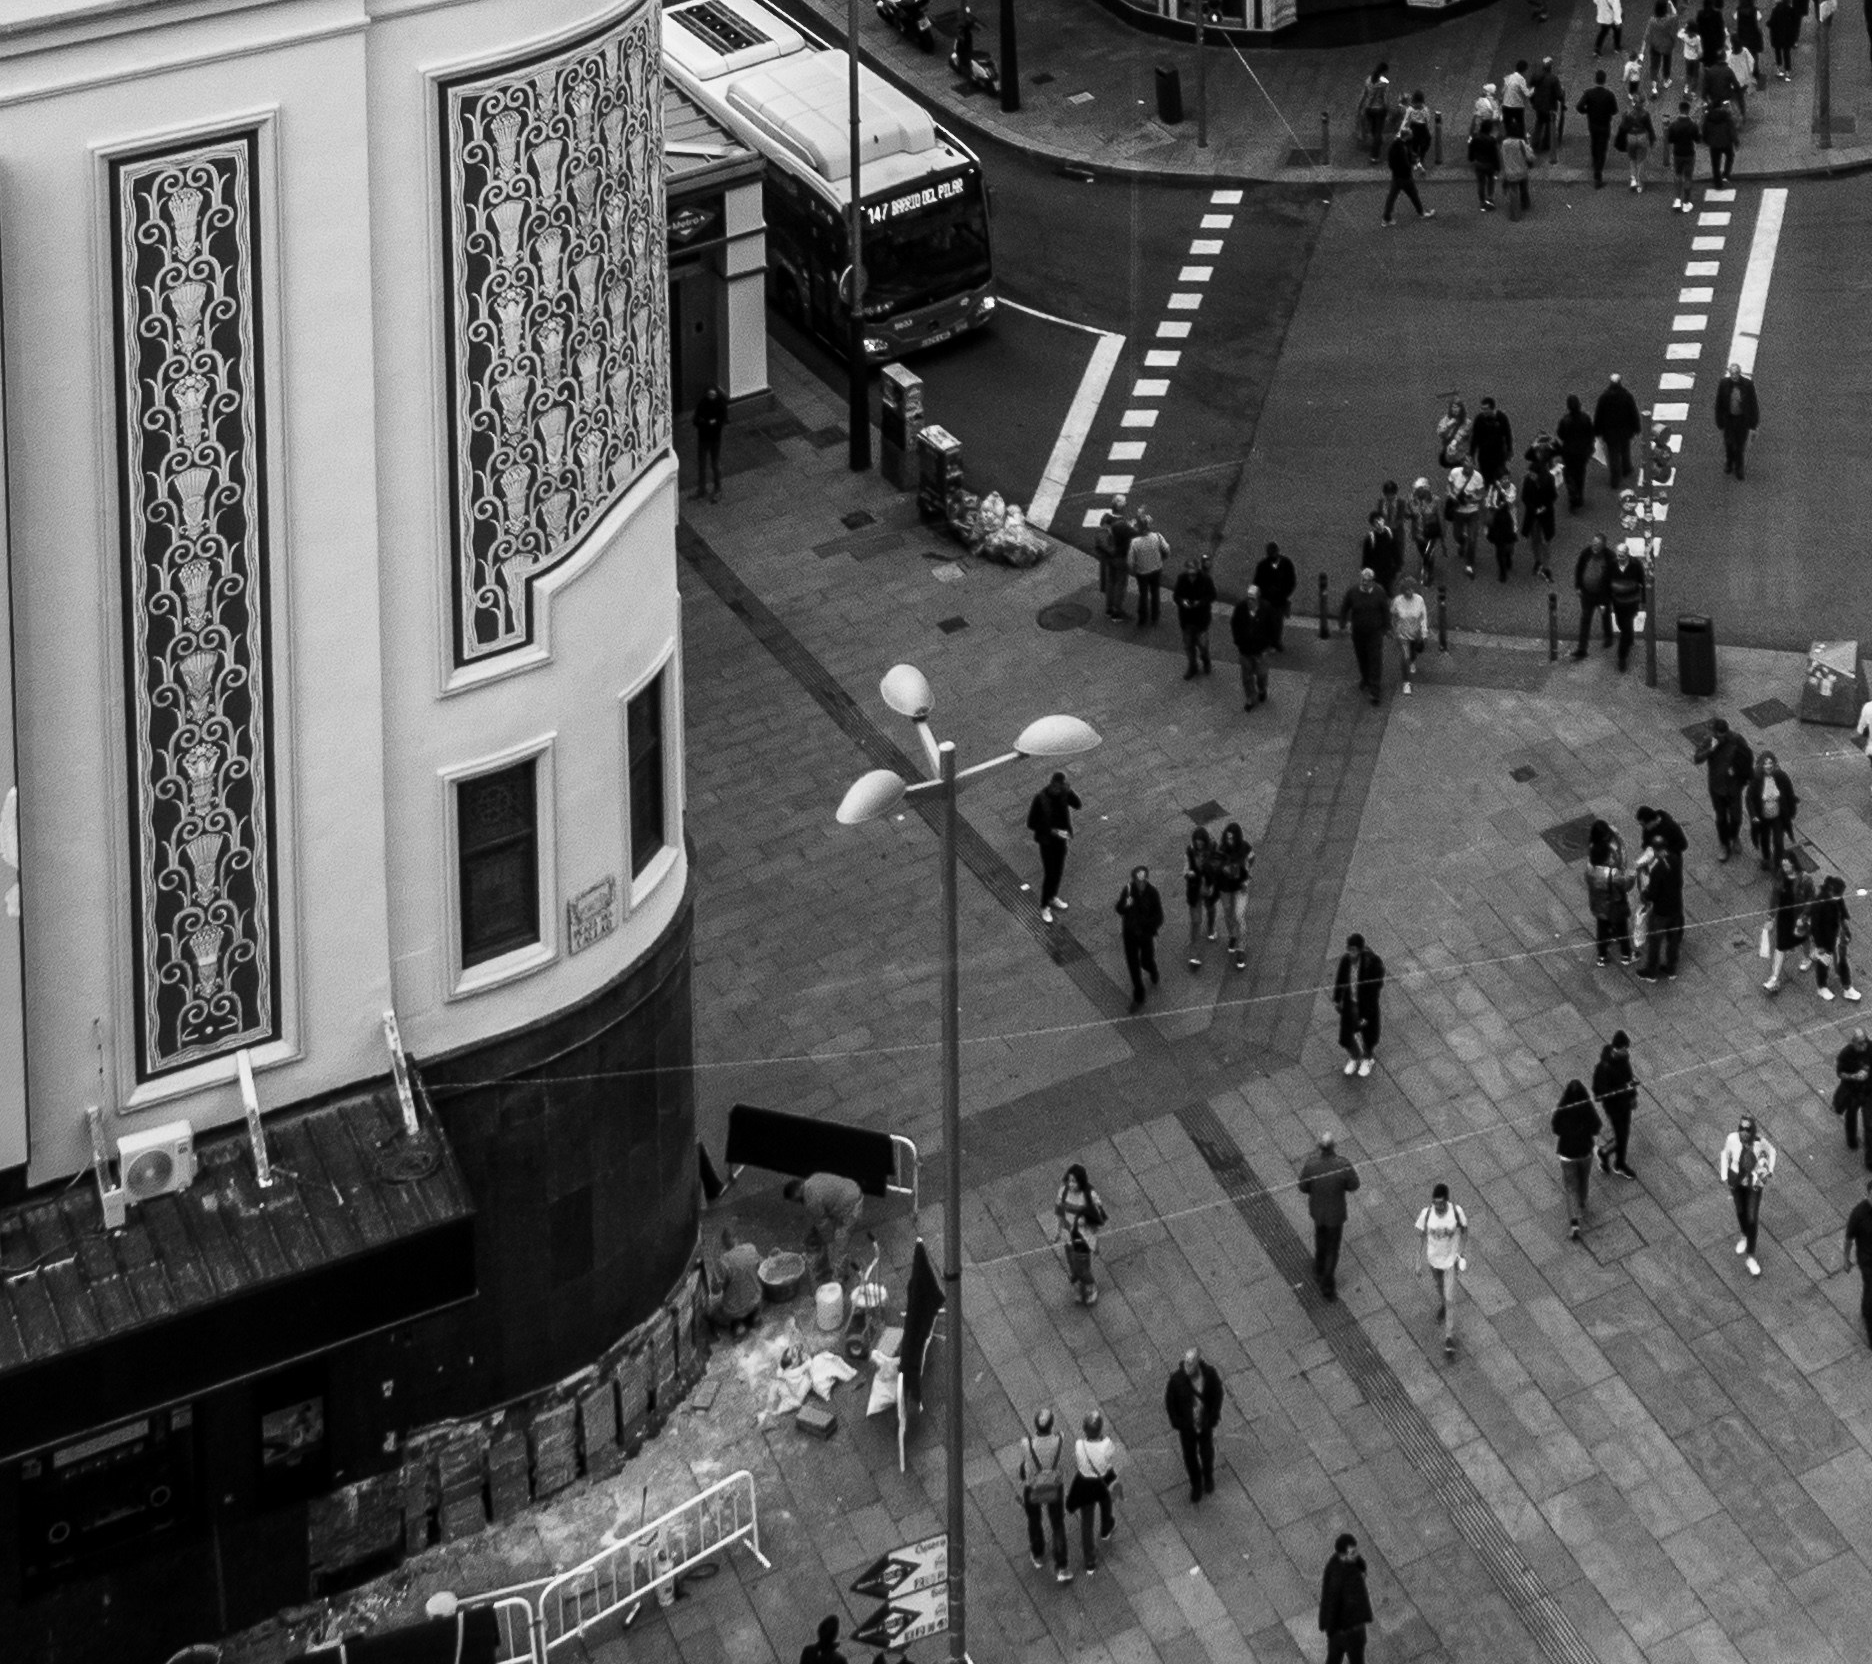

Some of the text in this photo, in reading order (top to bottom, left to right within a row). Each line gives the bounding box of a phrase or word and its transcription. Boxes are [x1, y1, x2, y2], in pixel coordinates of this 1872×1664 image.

[867, 202, 889, 224] 147
[922, 187, 938, 206] DEL
[938, 177, 964, 199] PILAR
[672, 217, 700, 230] Metro
